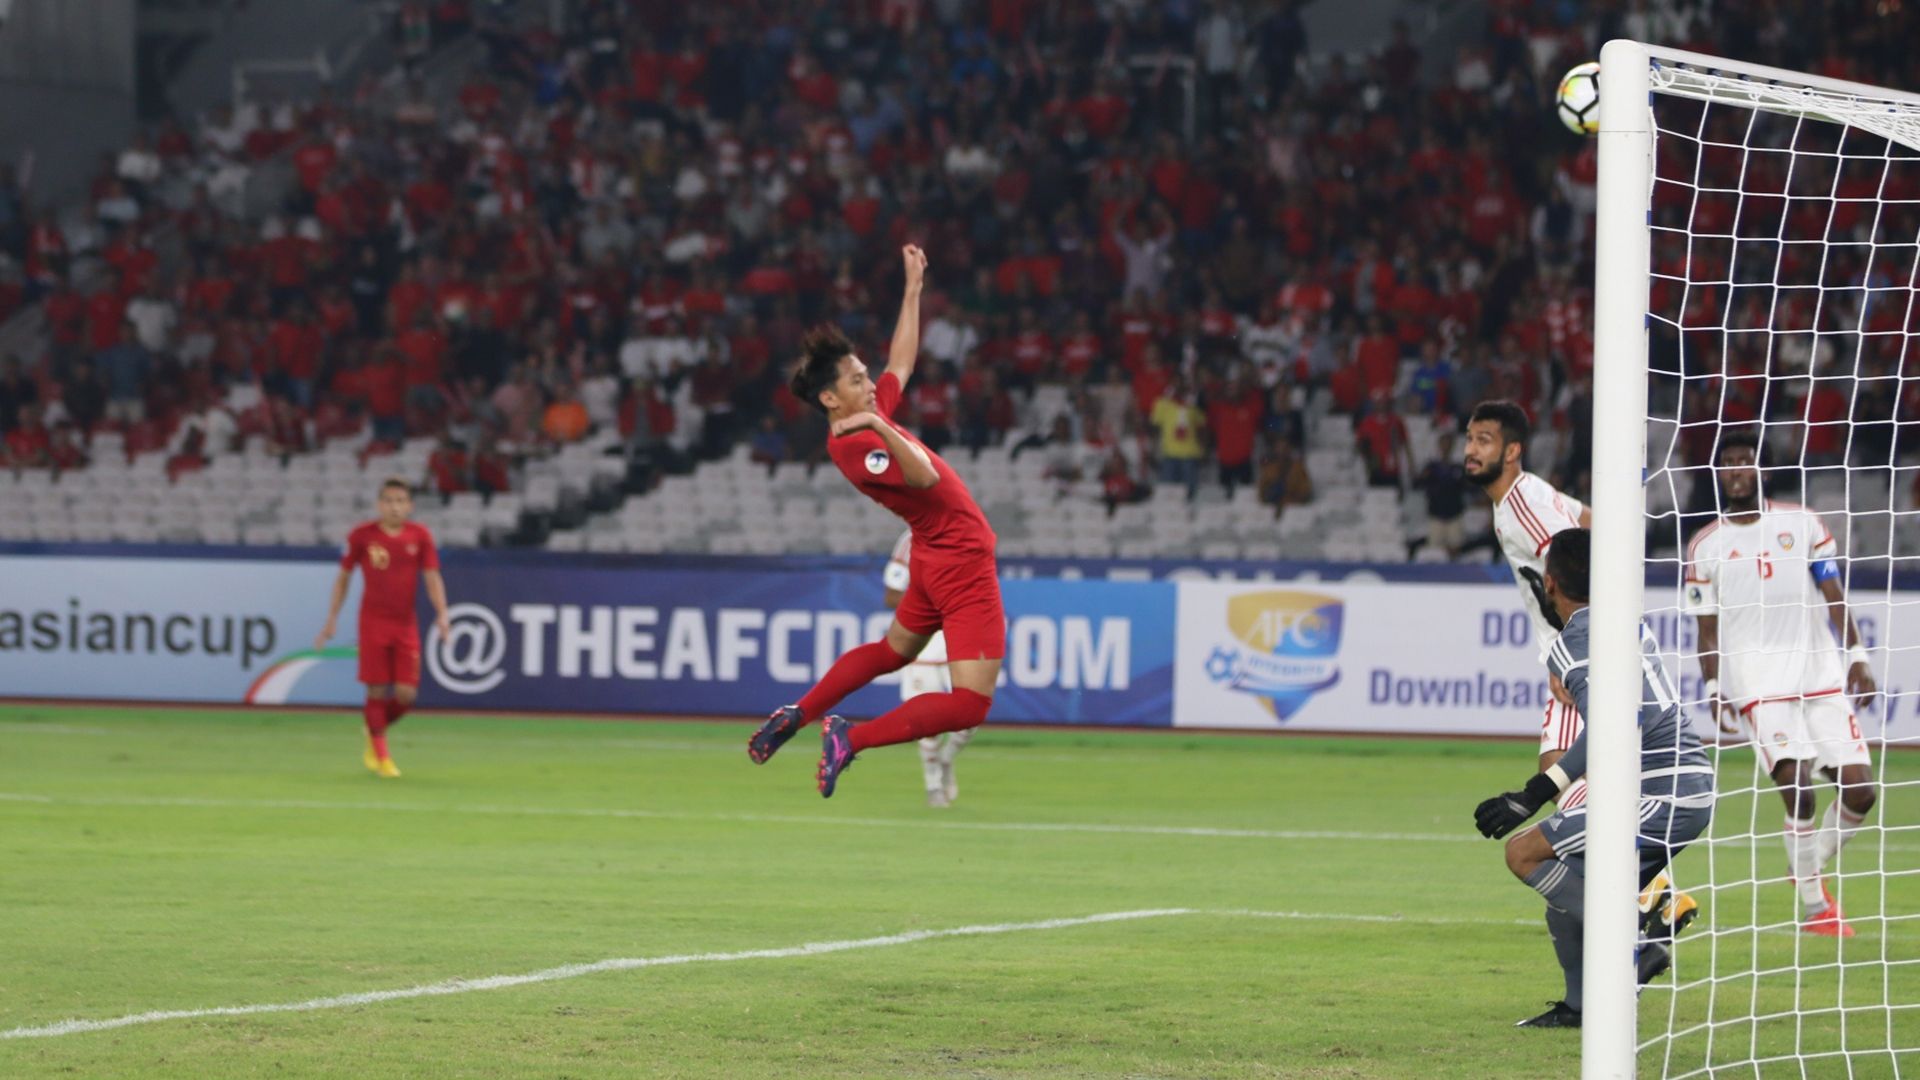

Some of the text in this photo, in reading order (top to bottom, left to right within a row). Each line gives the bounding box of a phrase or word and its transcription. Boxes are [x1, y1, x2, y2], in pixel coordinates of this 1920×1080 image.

[1756, 551, 1773, 580] 6
[0, 596, 278, 671] asiancup
[1481, 611, 1532, 647] DO
